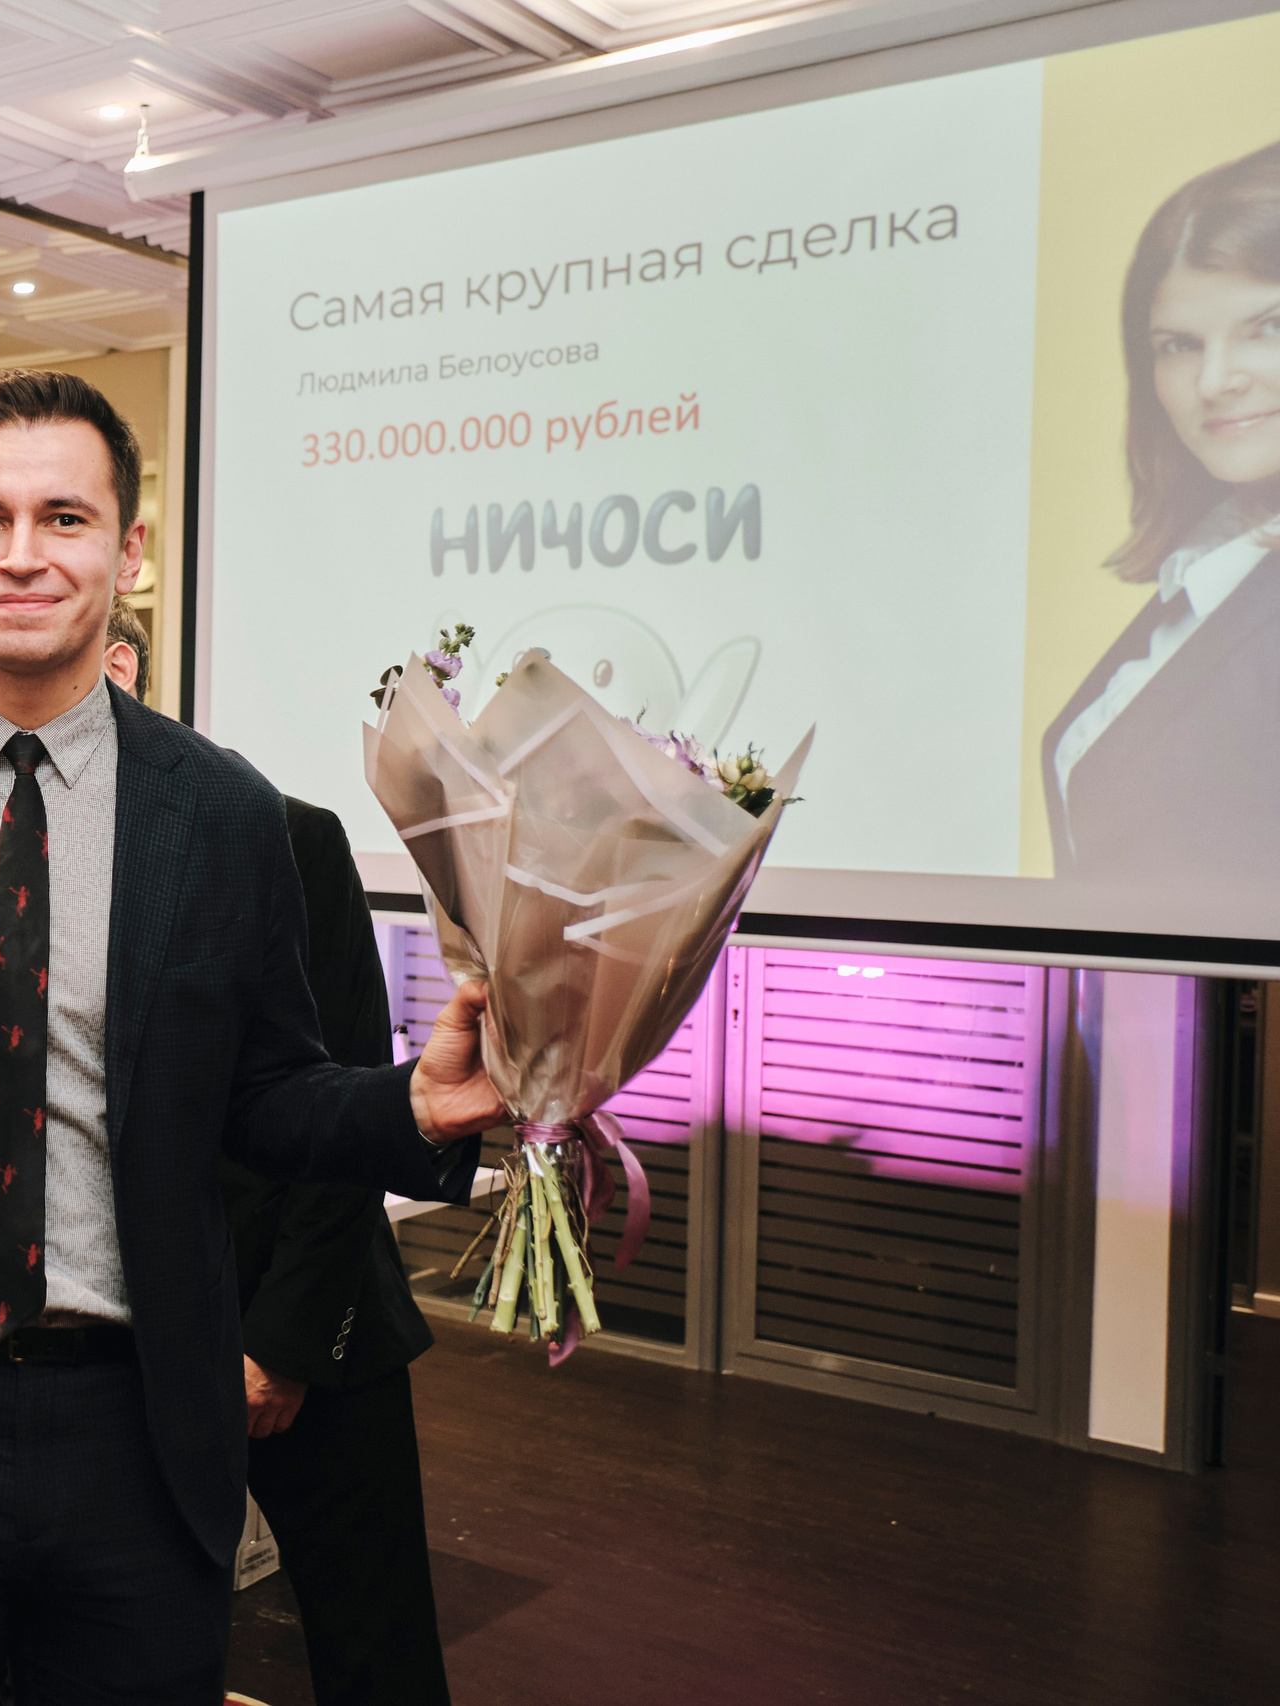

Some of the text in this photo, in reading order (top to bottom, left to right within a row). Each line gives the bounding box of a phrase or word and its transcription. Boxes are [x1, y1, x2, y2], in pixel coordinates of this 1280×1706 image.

[289, 203, 959, 332] Самая крупная сделка
[296, 342, 600, 397] Людмила Белоусова
[301, 391, 701, 467] 330.000.000 рублей
[430, 483, 762, 578] НИЧОСИ
